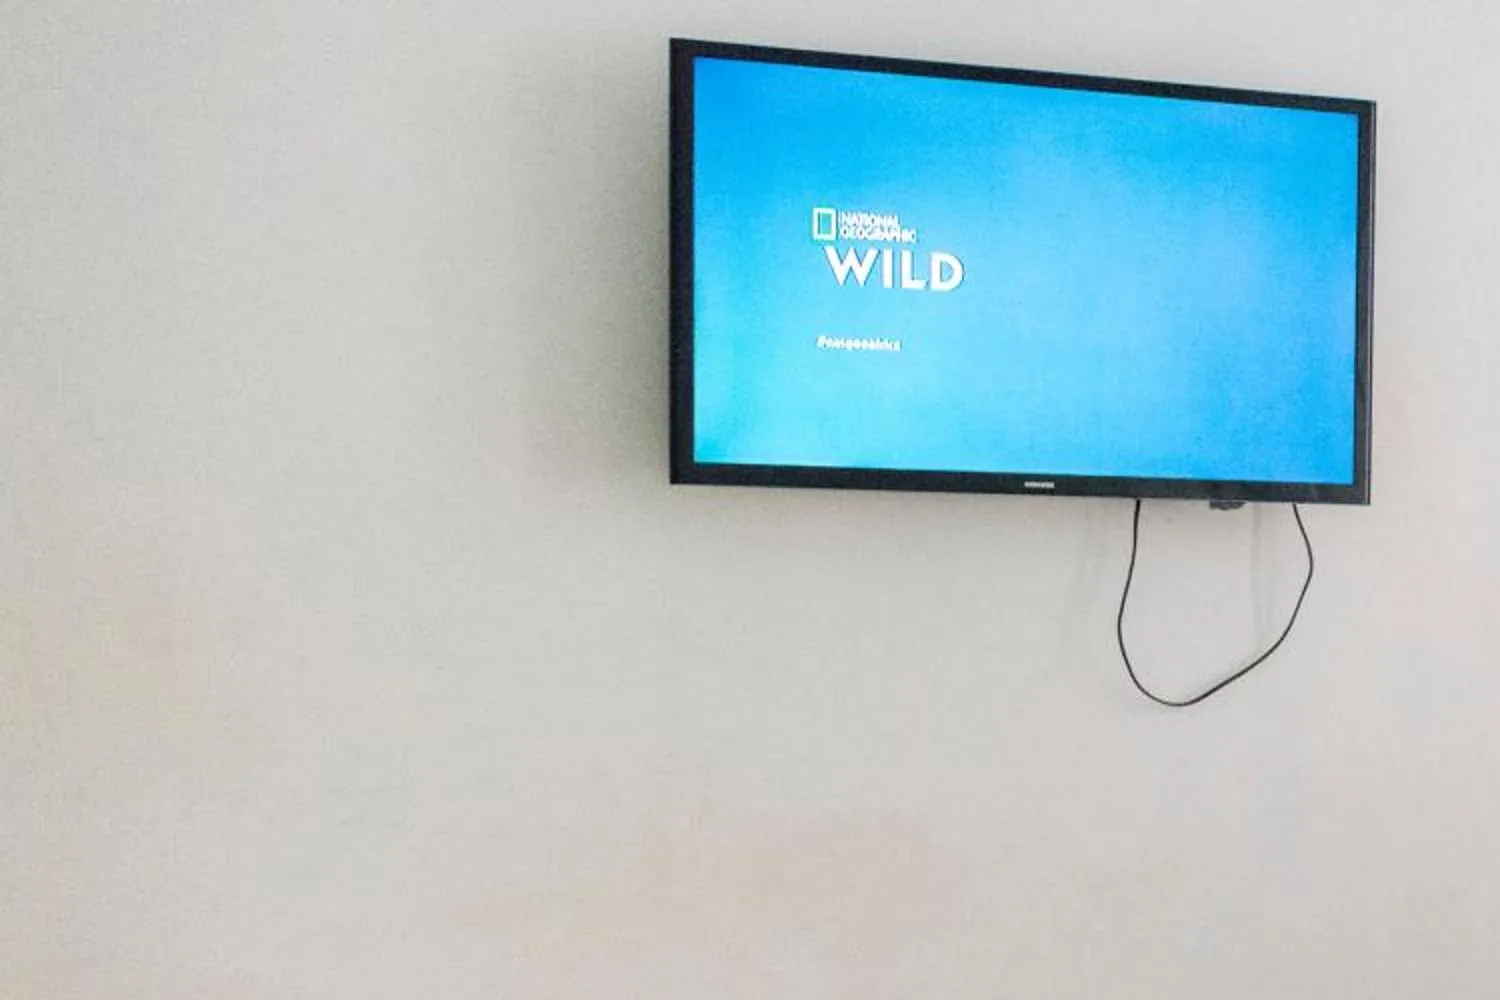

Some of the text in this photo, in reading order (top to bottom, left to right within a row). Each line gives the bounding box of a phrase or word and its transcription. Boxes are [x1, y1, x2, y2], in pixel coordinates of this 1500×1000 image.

[840, 211, 900, 228] NATIONAL
[840, 224, 917, 244] GEOGRAPHIC
[823, 246, 964, 291] WILD
